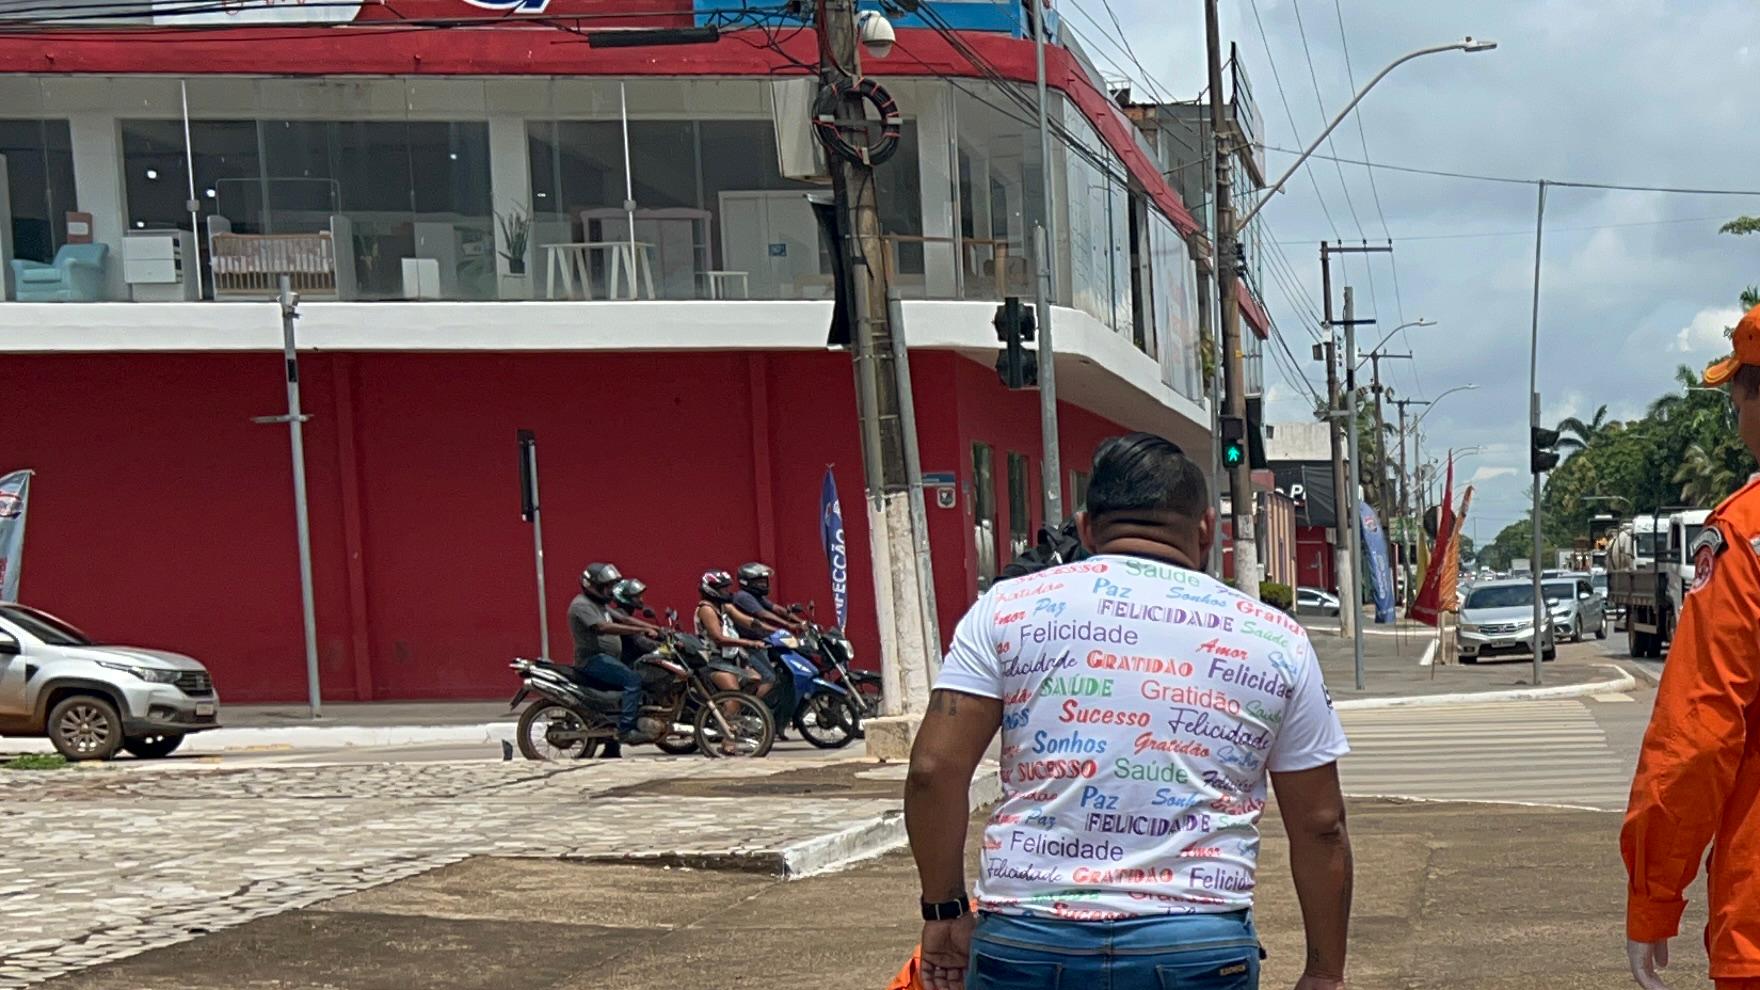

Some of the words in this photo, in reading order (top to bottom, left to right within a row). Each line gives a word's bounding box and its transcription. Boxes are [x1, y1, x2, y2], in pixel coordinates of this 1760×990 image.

[1092, 577, 1133, 599] Paz
[1098, 597, 1235, 633] FELICIDADE
[1020, 619, 1139, 646] Felicidade
[1196, 638, 1250, 661] Amor
[1141, 679, 1241, 716] Gratidão
[1059, 699, 1152, 728] Sucesso
[1032, 730, 1108, 755] Sonhos
[1134, 732, 1211, 758] Gratidão
[1018, 758, 1099, 783] SUCESSO
[1114, 756, 1189, 785] Saúde
[1080, 784, 1120, 811] Paz
[1085, 812, 1211, 838] FELICIDADE
[1010, 829, 1124, 863] Felicidade
